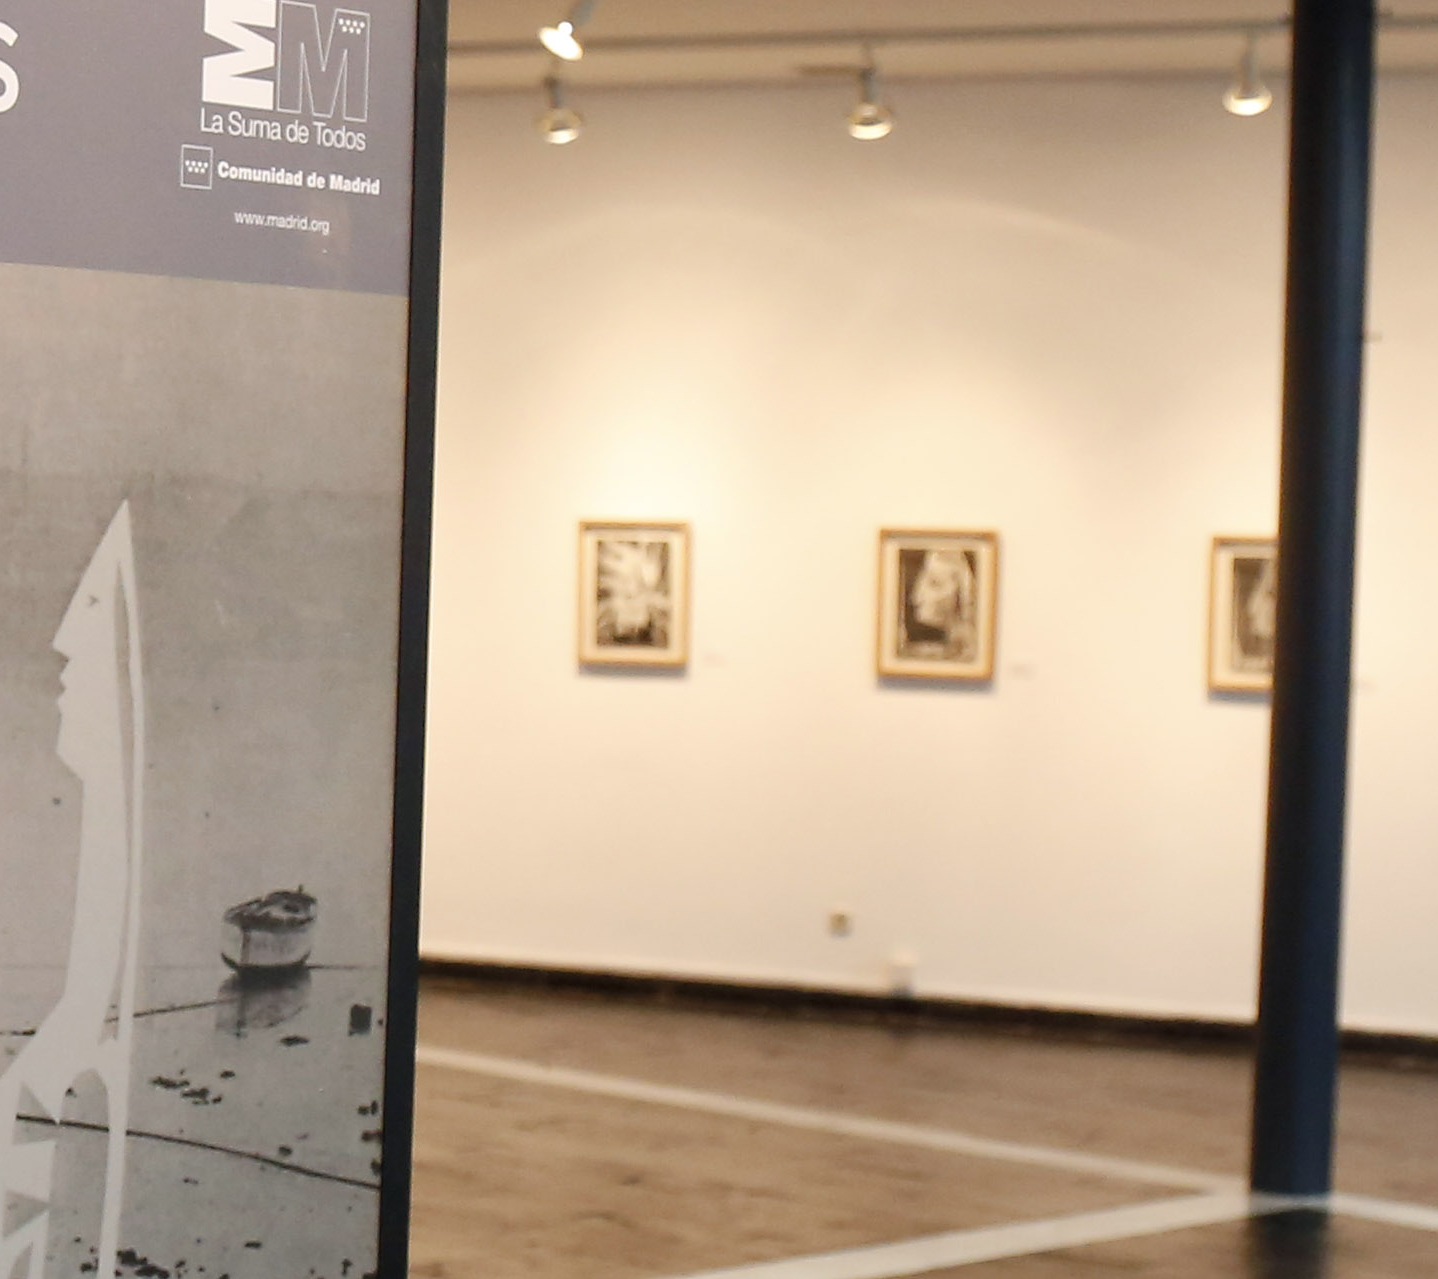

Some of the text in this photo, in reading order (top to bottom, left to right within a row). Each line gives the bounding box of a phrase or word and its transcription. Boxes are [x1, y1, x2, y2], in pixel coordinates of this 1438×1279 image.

[200, 107, 366, 151] La Suma de Todos
[217, 161, 380, 195] Comunidad de Madrid
[233, 209, 331, 237] www.madrid.org
